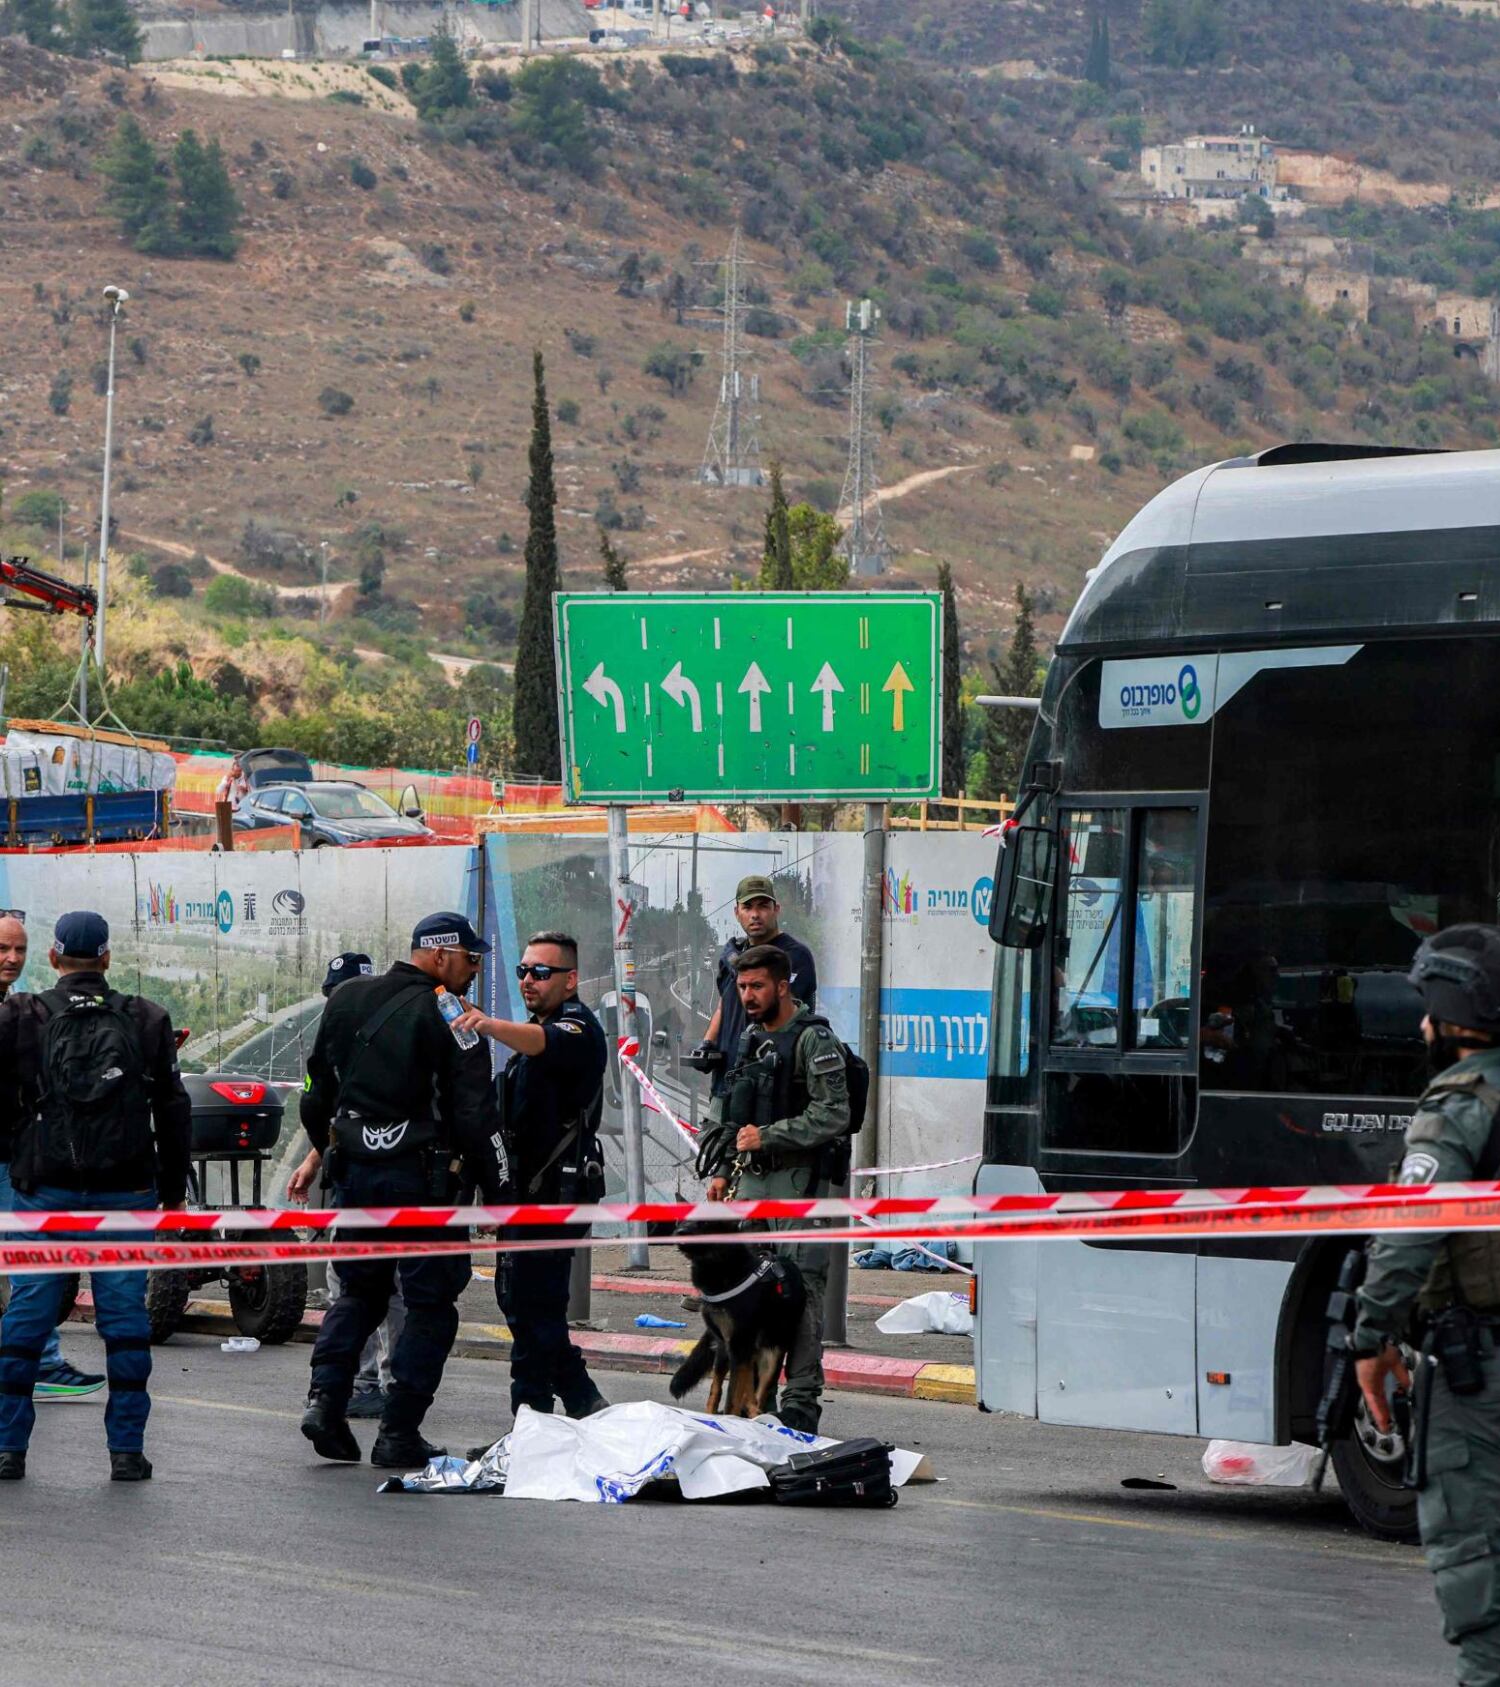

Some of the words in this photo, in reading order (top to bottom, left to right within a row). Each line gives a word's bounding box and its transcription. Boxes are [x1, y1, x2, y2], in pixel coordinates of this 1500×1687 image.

[1121, 684, 1176, 707] סופרבוס
[928, 889, 968, 908] מוריה
[185, 902, 216, 918] מוריה
[422, 934, 457, 946] משטרה
[940, 1012, 988, 1061] לדרך
[1322, 1113, 1385, 1132] GOLDEN
[490, 1131, 510, 1187] BERIK
